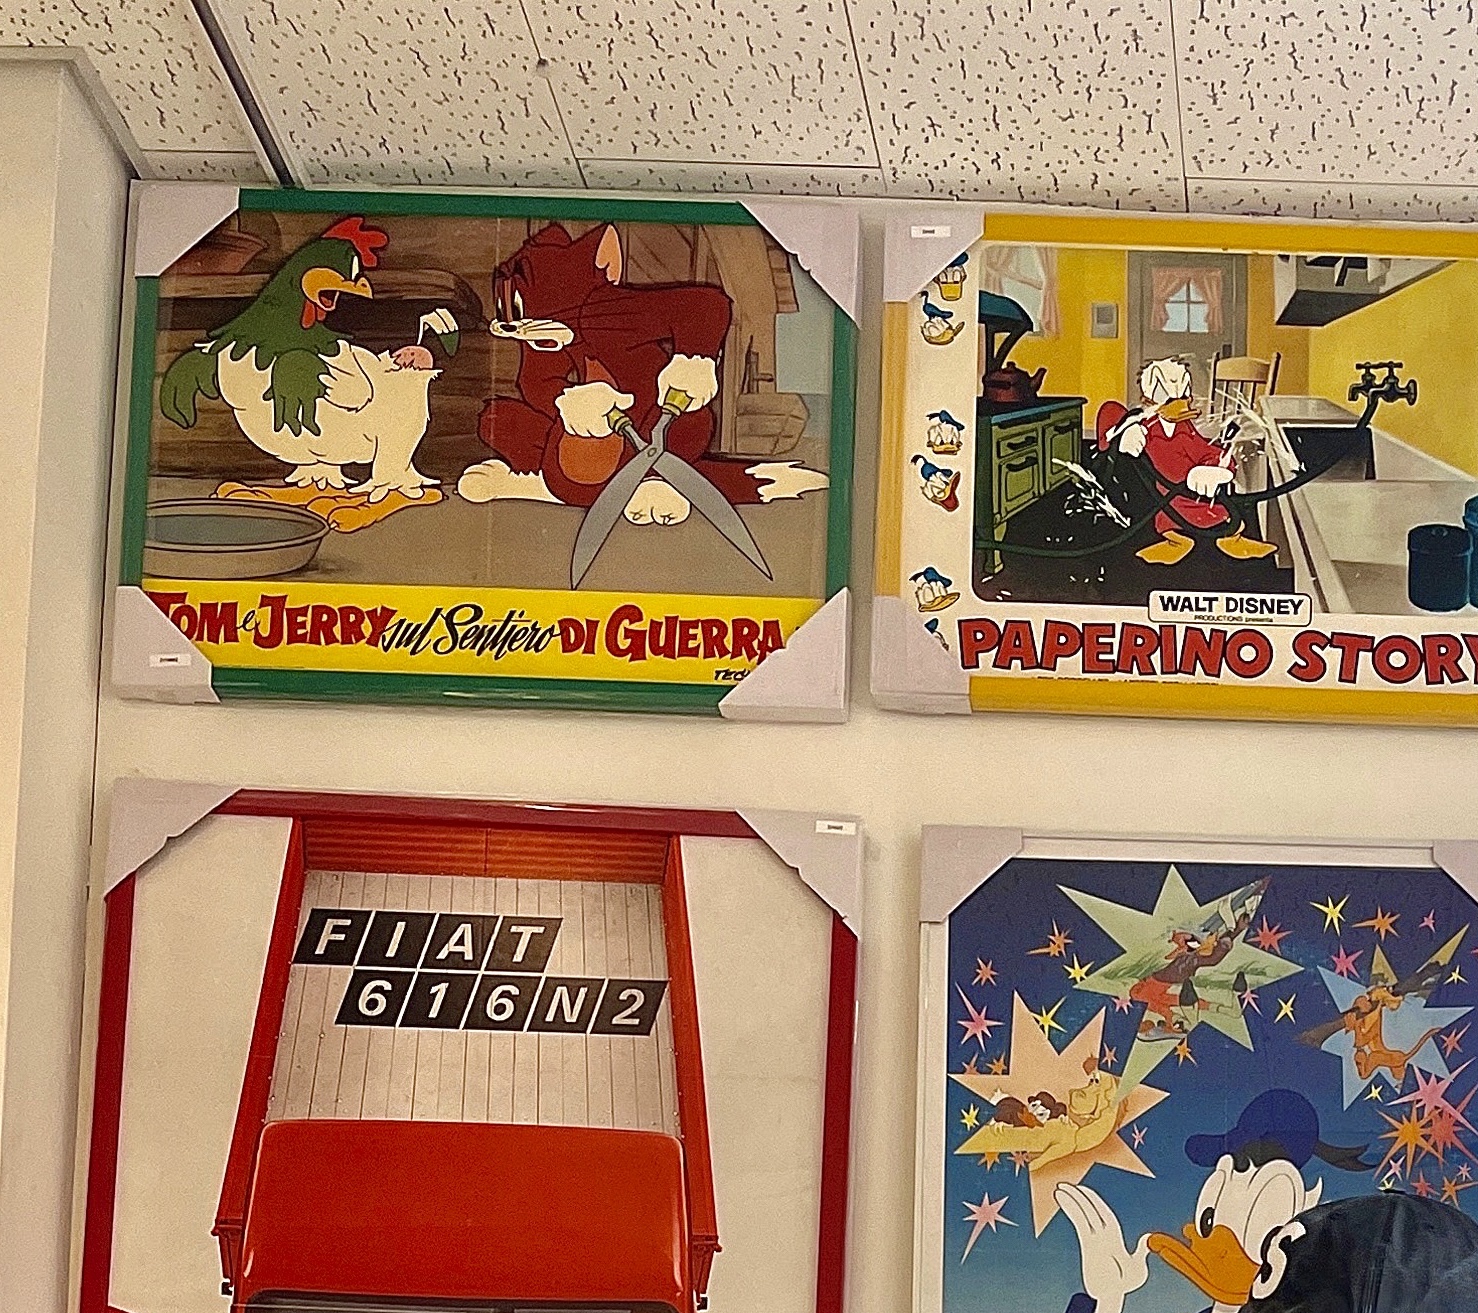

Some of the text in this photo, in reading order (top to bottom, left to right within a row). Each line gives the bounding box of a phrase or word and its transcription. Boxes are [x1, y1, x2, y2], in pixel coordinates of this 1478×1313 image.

[1159, 595, 1305, 616] WALT DISNEY
[253, 594, 399, 649] JERRY
[380, 607, 443, 652] sul
[558, 617, 600, 655] DI
[605, 604, 787, 665] GUERRA
[957, 618, 1274, 679] PAPERINO
[314, 917, 546, 964] FIAT
[357, 979, 646, 1026] 616N2
